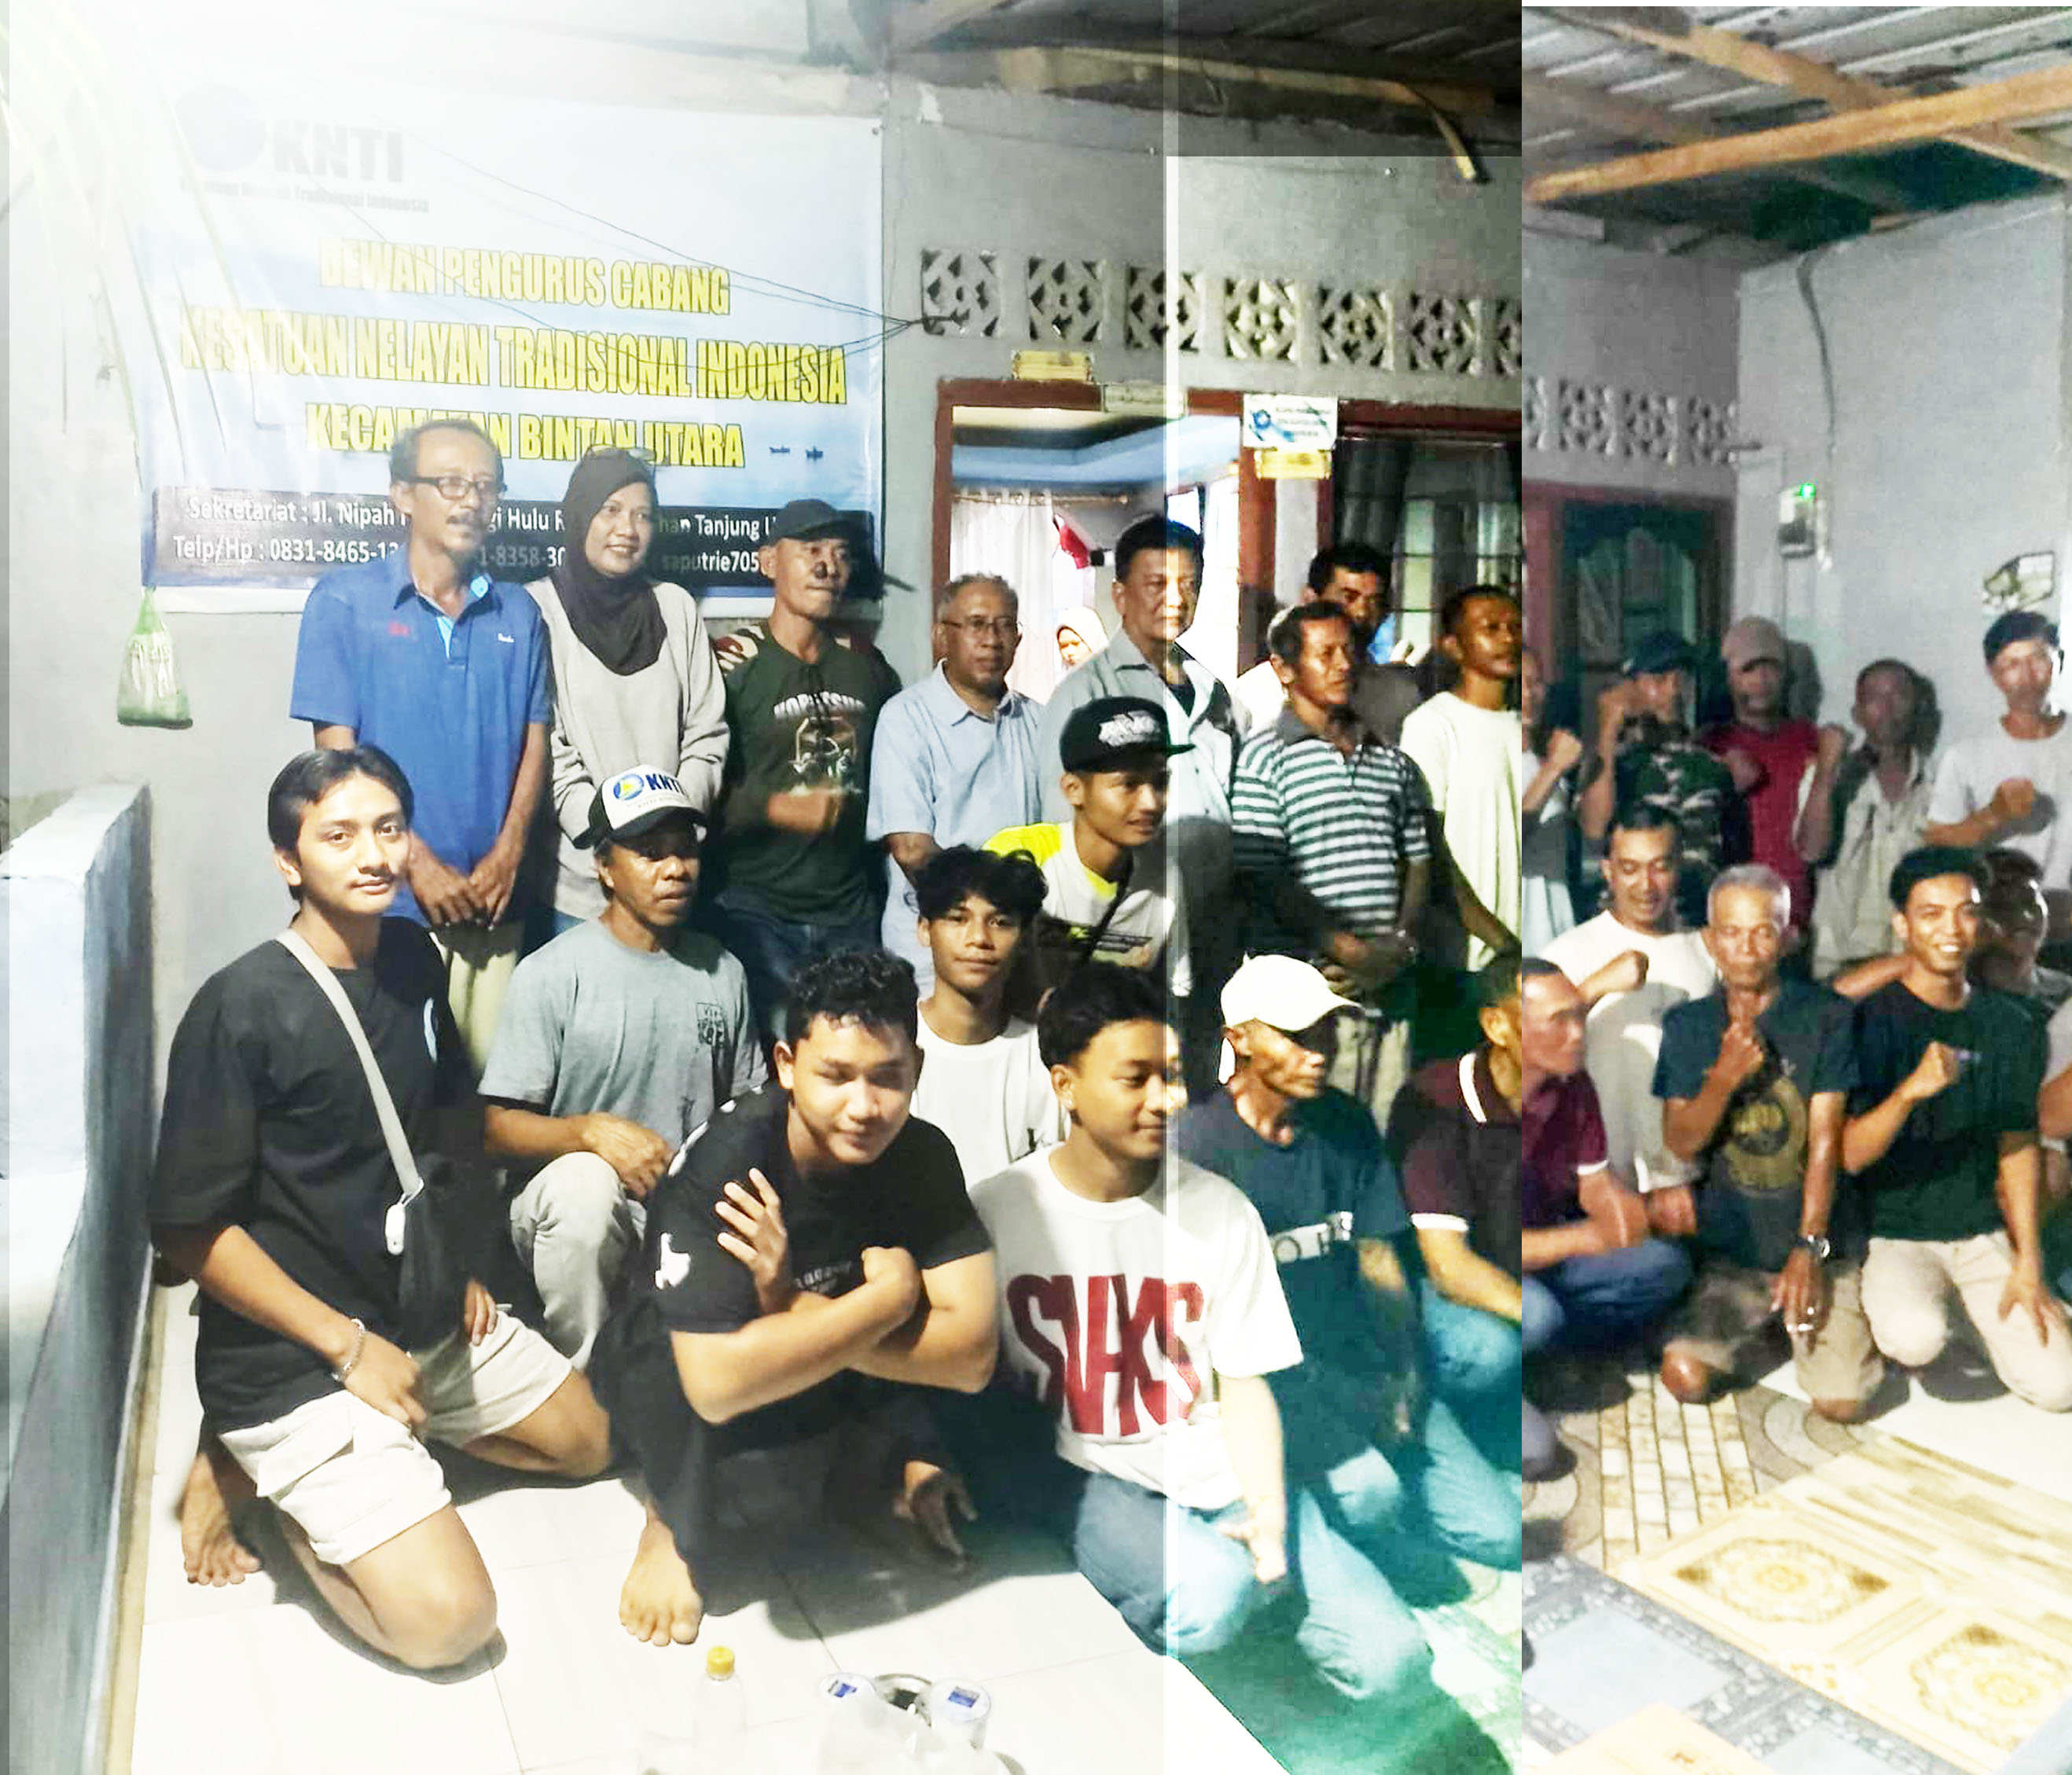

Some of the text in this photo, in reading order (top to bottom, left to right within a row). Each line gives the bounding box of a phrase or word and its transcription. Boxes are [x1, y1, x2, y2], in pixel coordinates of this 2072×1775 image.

[273, 119, 403, 182] KNTI
[319, 237, 731, 315] DEWAN PENGURUS CABANG
[180, 307, 847, 405] KESATUAN NELAYAN TRADISIONAL INDONESIA
[643, 421, 745, 469] UTARA
[189, 496, 297, 522] Sekretariat
[313, 500, 333, 523] Jl.
[336, 502, 395, 530] Nipah
[507, 507, 549, 531] Hulu
[695, 514, 760, 542] Tanjung
[173, 535, 254, 564] Telp/Hp
